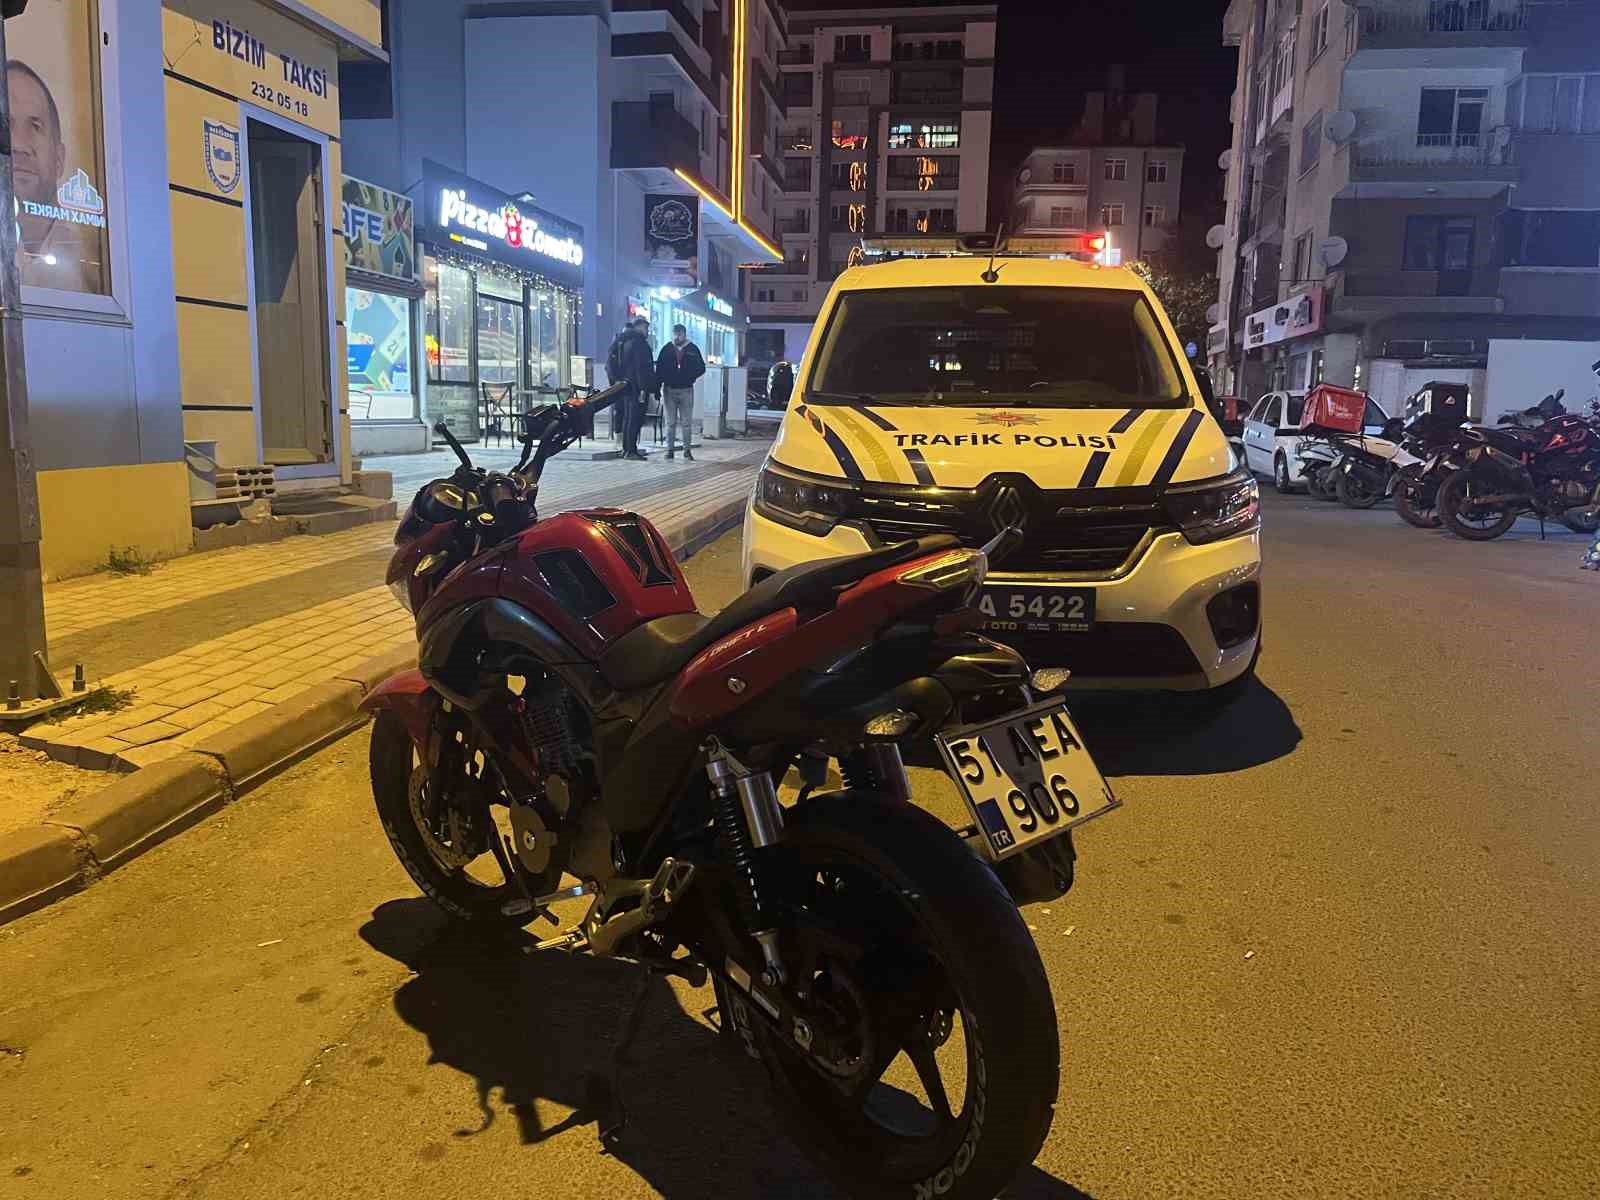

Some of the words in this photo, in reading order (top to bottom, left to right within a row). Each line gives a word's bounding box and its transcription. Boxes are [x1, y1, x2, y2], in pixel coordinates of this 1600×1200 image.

[213, 19, 266, 70] BİZİM
[280, 53, 327, 99] TAKSİ
[252, 81, 273, 102] 232
[277, 91, 291, 110] 05
[294, 101, 308, 116] 18
[894, 432, 1003, 446] TRAFİK
[1014, 433, 1116, 449] POLİSİ
[1008, 594, 1086, 619] 5422
[950, 735, 1002, 785] 51
[1006, 713, 1081, 768] AEA
[1006, 774, 1081, 834] 906
[992, 829, 1012, 848] TR
